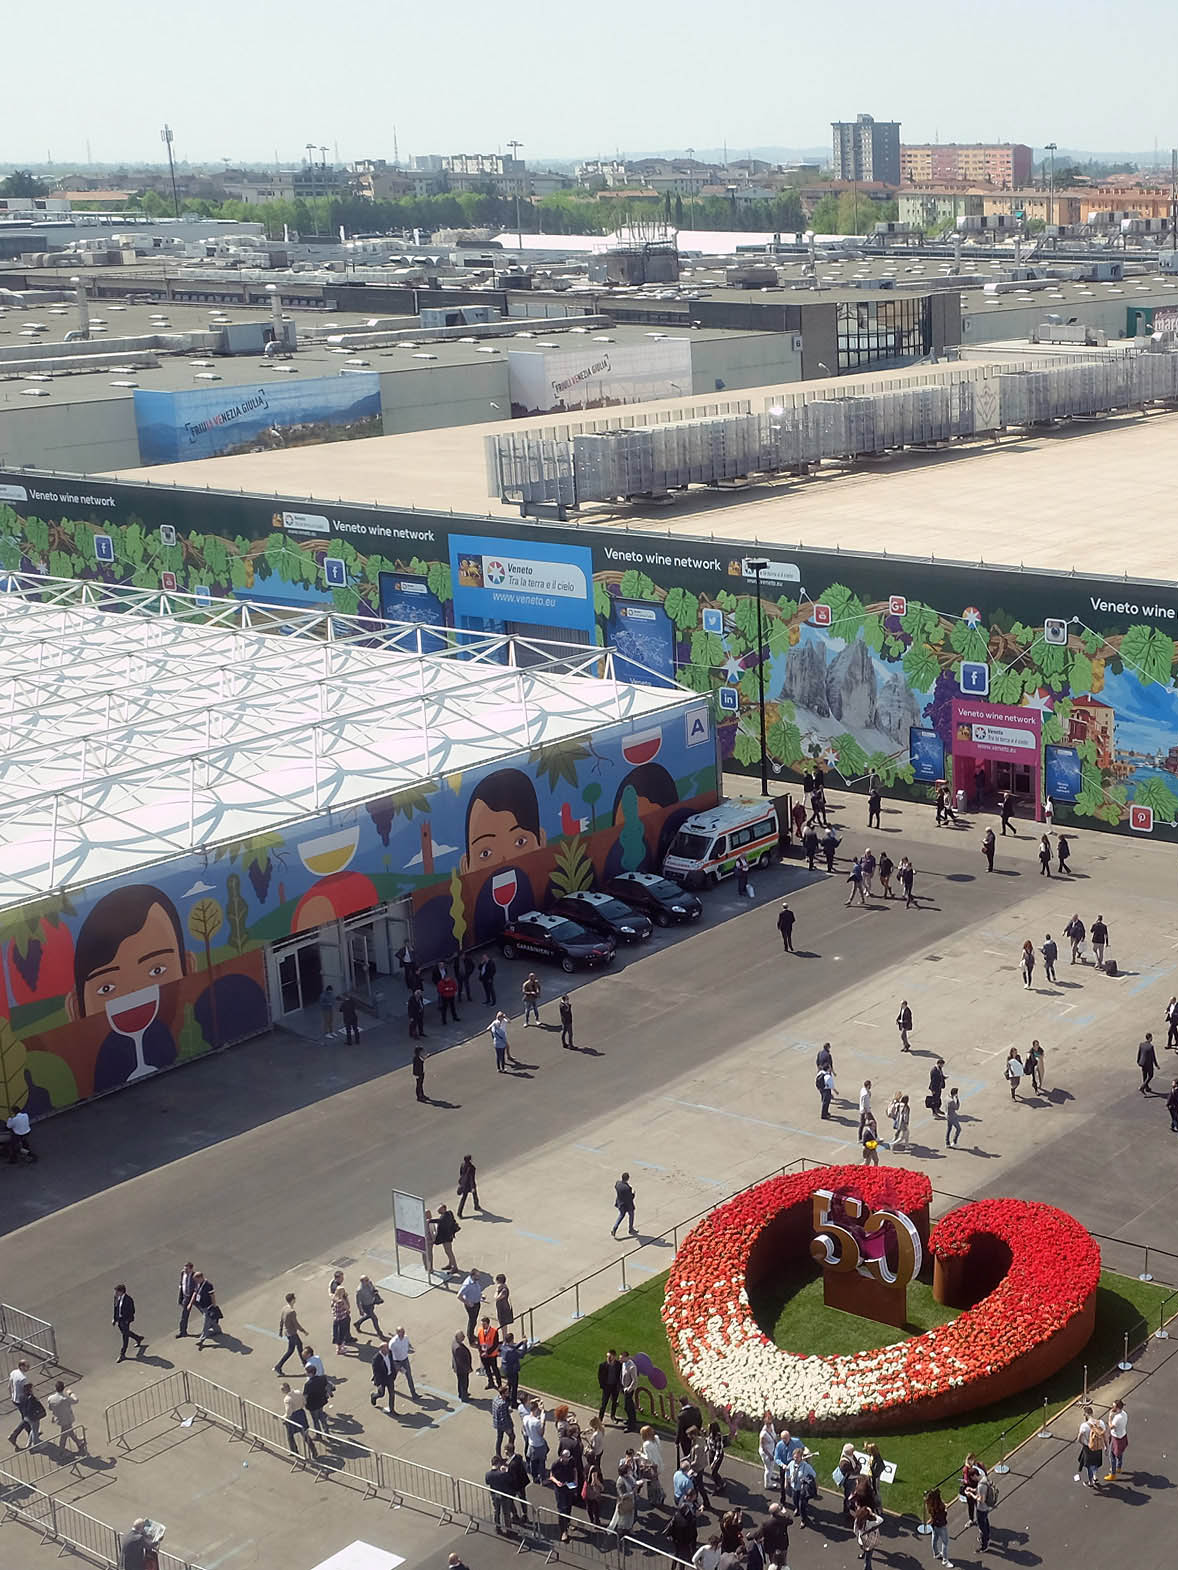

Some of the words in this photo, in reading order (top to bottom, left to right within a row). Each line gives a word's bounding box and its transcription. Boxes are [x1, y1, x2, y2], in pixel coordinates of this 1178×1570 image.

[591, 360, 608, 374] GIULIA
[190, 419, 213, 437] FRIULI
[212, 406, 241, 425] VENEZIA
[241, 396, 264, 413] GIULIA
[29, 489, 59, 501] Veneto
[60, 493, 79, 504] wine
[80, 496, 116, 507] network
[333, 520, 367, 534] Veneto
[368, 525, 393, 537] wine
[393, 528, 434, 541] network
[604, 547, 643, 563] Veneto
[645, 552, 673, 566] wine
[674, 554, 721, 571] network
[507, 563, 533, 575] Veneto
[508, 575, 520, 586] Tra
[520, 577, 527, 586] la
[528, 578, 545, 589] terra
[552, 580, 556, 590] il
[557, 581, 575, 592] cielo
[492, 592, 556, 607] www.veneto.eu
[1090, 597, 1139, 615] Veneto
[1142, 604, 1175, 620] wine
[958, 708, 985, 718] Veneto
[986, 711, 1004, 720] wine
[1004, 714, 1036, 725] network
[691, 718, 704, 736] A
[810, 1189, 923, 1289] 50
